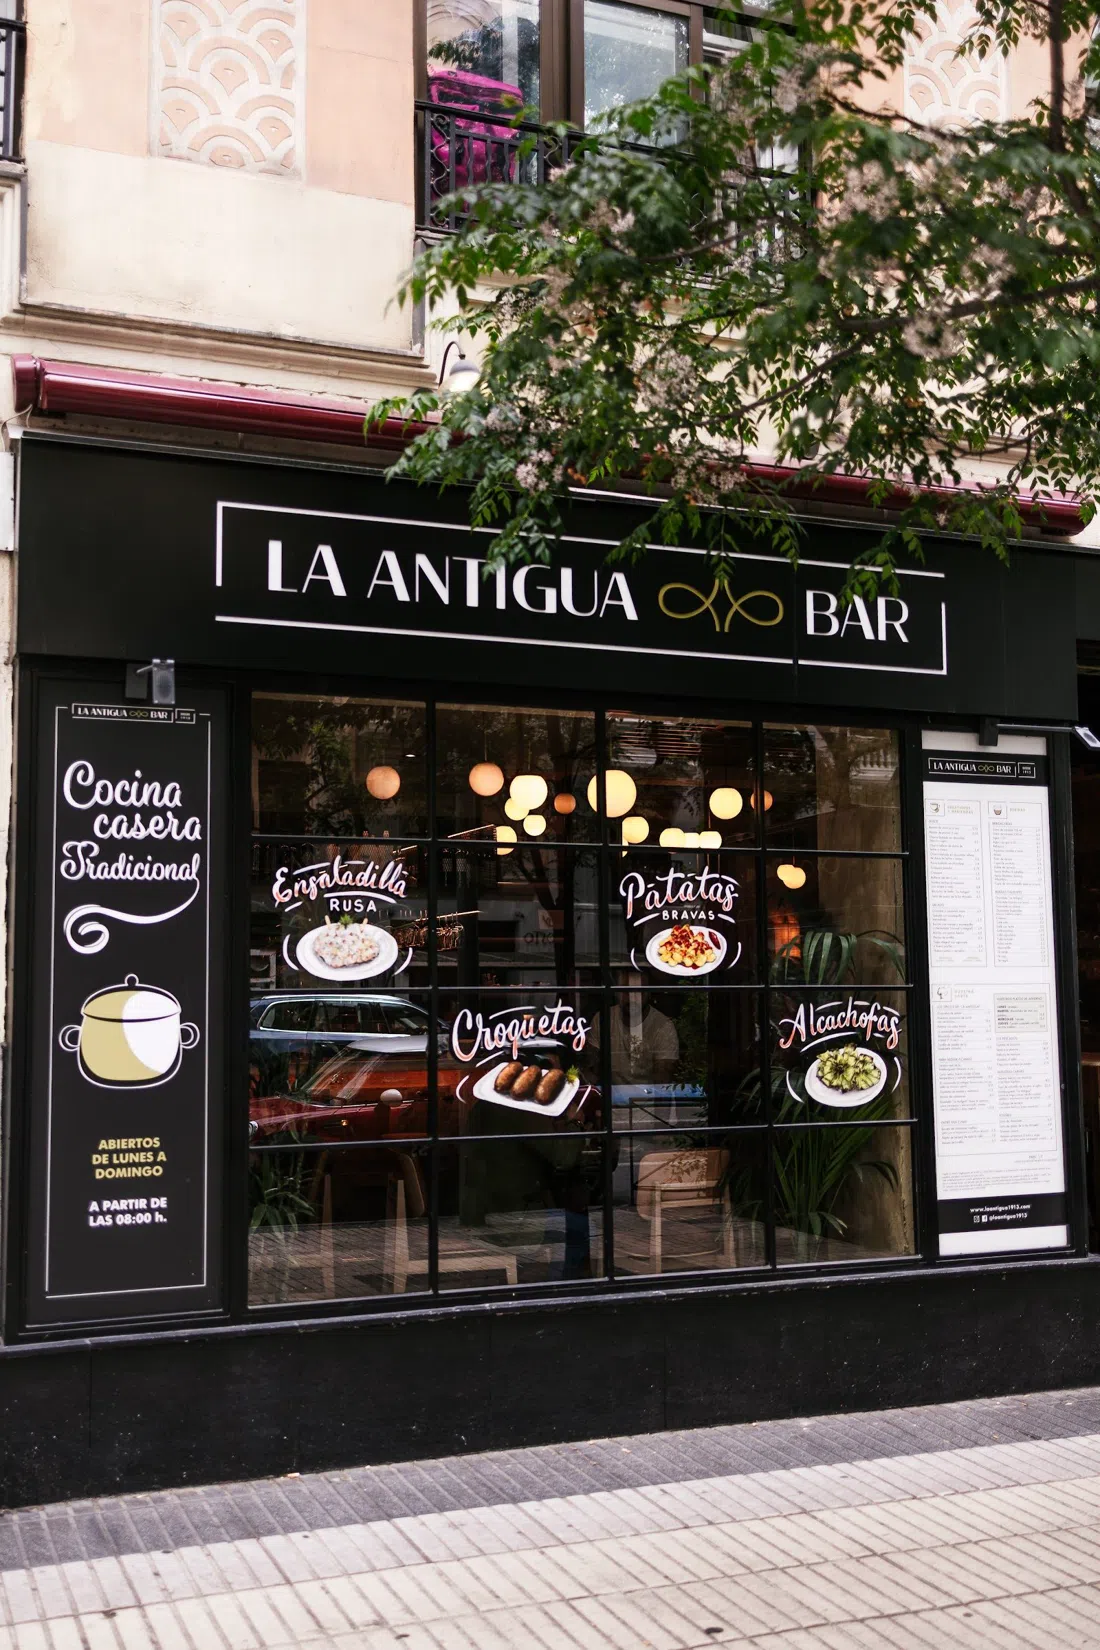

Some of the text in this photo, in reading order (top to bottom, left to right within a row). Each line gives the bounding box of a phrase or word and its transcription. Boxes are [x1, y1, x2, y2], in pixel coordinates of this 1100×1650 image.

[268, 539, 909, 643] LA ANTIGUA BAR
[77, 707, 168, 719] LA ANTIGUA BAR
[933, 762, 943, 770] LA
[944, 762, 977, 772] ANTIGUA
[996, 765, 1012, 774] BAR
[63, 760, 182, 810] Cocina
[93, 811, 202, 840] casera
[60, 841, 200, 881] Tradicional
[272, 854, 408, 908] Ensaladilla
[619, 865, 739, 919] Patatas
[329, 898, 377, 913] RUSA
[662, 910, 715, 920] BRAVAS
[452, 998, 592, 1062] Croquetas
[778, 996, 903, 1050] Alcachofas
[98, 1137, 160, 1150] ABIERTOS
[92, 1151, 167, 1165] DE LUNES A
[95, 1165, 163, 1179] DOMINGO
[89, 1197, 168, 1212] A PARTIR DE
[89, 1211, 168, 1227] LAS 08:00 h.
